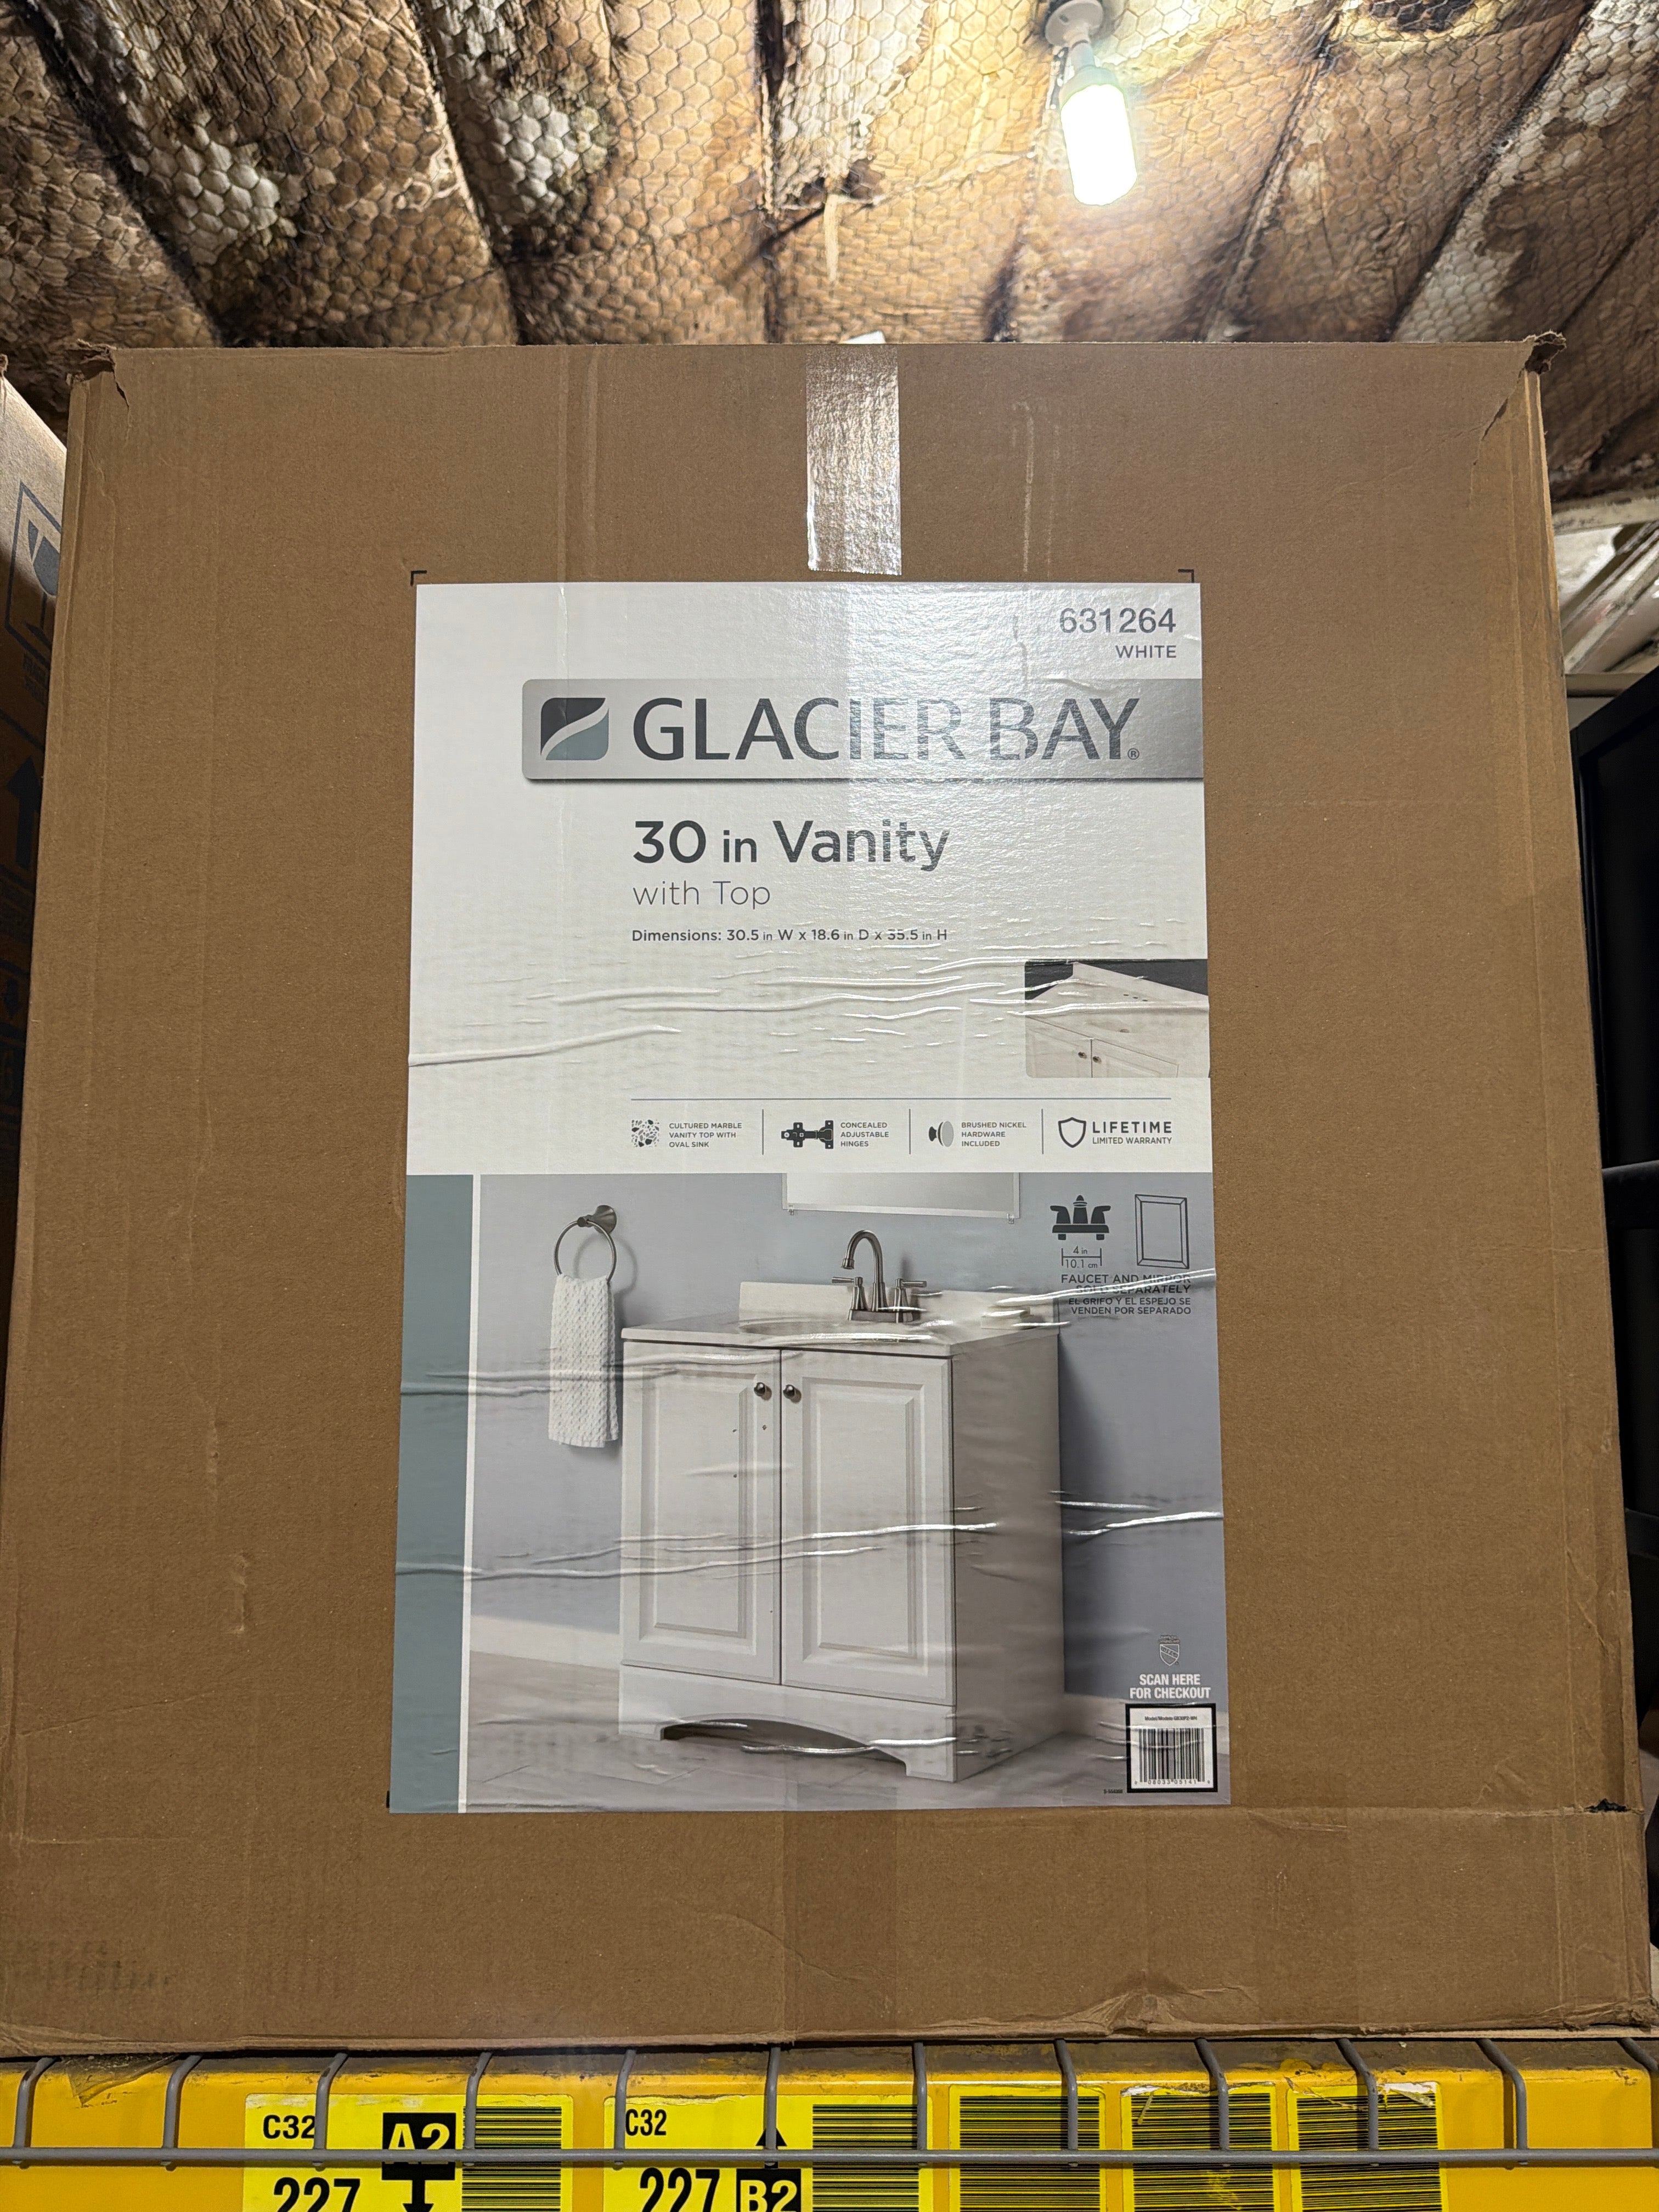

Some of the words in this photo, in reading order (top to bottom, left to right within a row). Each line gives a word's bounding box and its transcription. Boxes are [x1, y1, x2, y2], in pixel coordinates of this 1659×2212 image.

[1059, 608, 1176, 633] 631264
[1115, 645, 1177, 658] WHITE
[633, 696, 964, 761] GLACIER
[633, 820, 706, 864] 30
[723, 831, 757, 863] in
[772, 819, 949, 871] Vanity
[633, 881, 699, 906] with
[713, 881, 771, 910] Top
[633, 929, 721, 941] Dimensions:
[727, 929, 759, 941] 30.5
[763, 931, 772, 941] in
[777, 929, 794, 941] W
[798, 932, 806, 941] x
[811, 929, 840, 940] 18.6
[844, 930, 853, 940] in
[859, 929, 869, 940] D
[874, 932, 882, 940] x
[922, 930, 932, 940] in
[937, 929, 947, 940] H
[1092, 1121, 1172, 1133] LIFETIME
[1073, 1245, 1079, 1254] 4
[1065, 1259, 1085, 1268] 10.1
[1061, 1274, 1109, 1283] FAUCET
[1113, 1274, 1139, 1283] AND
[1139, 1674, 1169, 1685] SCAN
[1172, 1674, 1200, 1685] HERE
[1130, 1687, 1152, 1699] FOR
[1154, 1687, 1211, 1699] CHECKOUT
[263, 2114, 316, 2139] C32
[625, 2109, 667, 2136] C32
[385, 2123, 450, 2164] A2
[274, 2177, 361, 2212] 227
[639, 2168, 720, 2212] 227
[740, 2179, 798, 2212] B2
